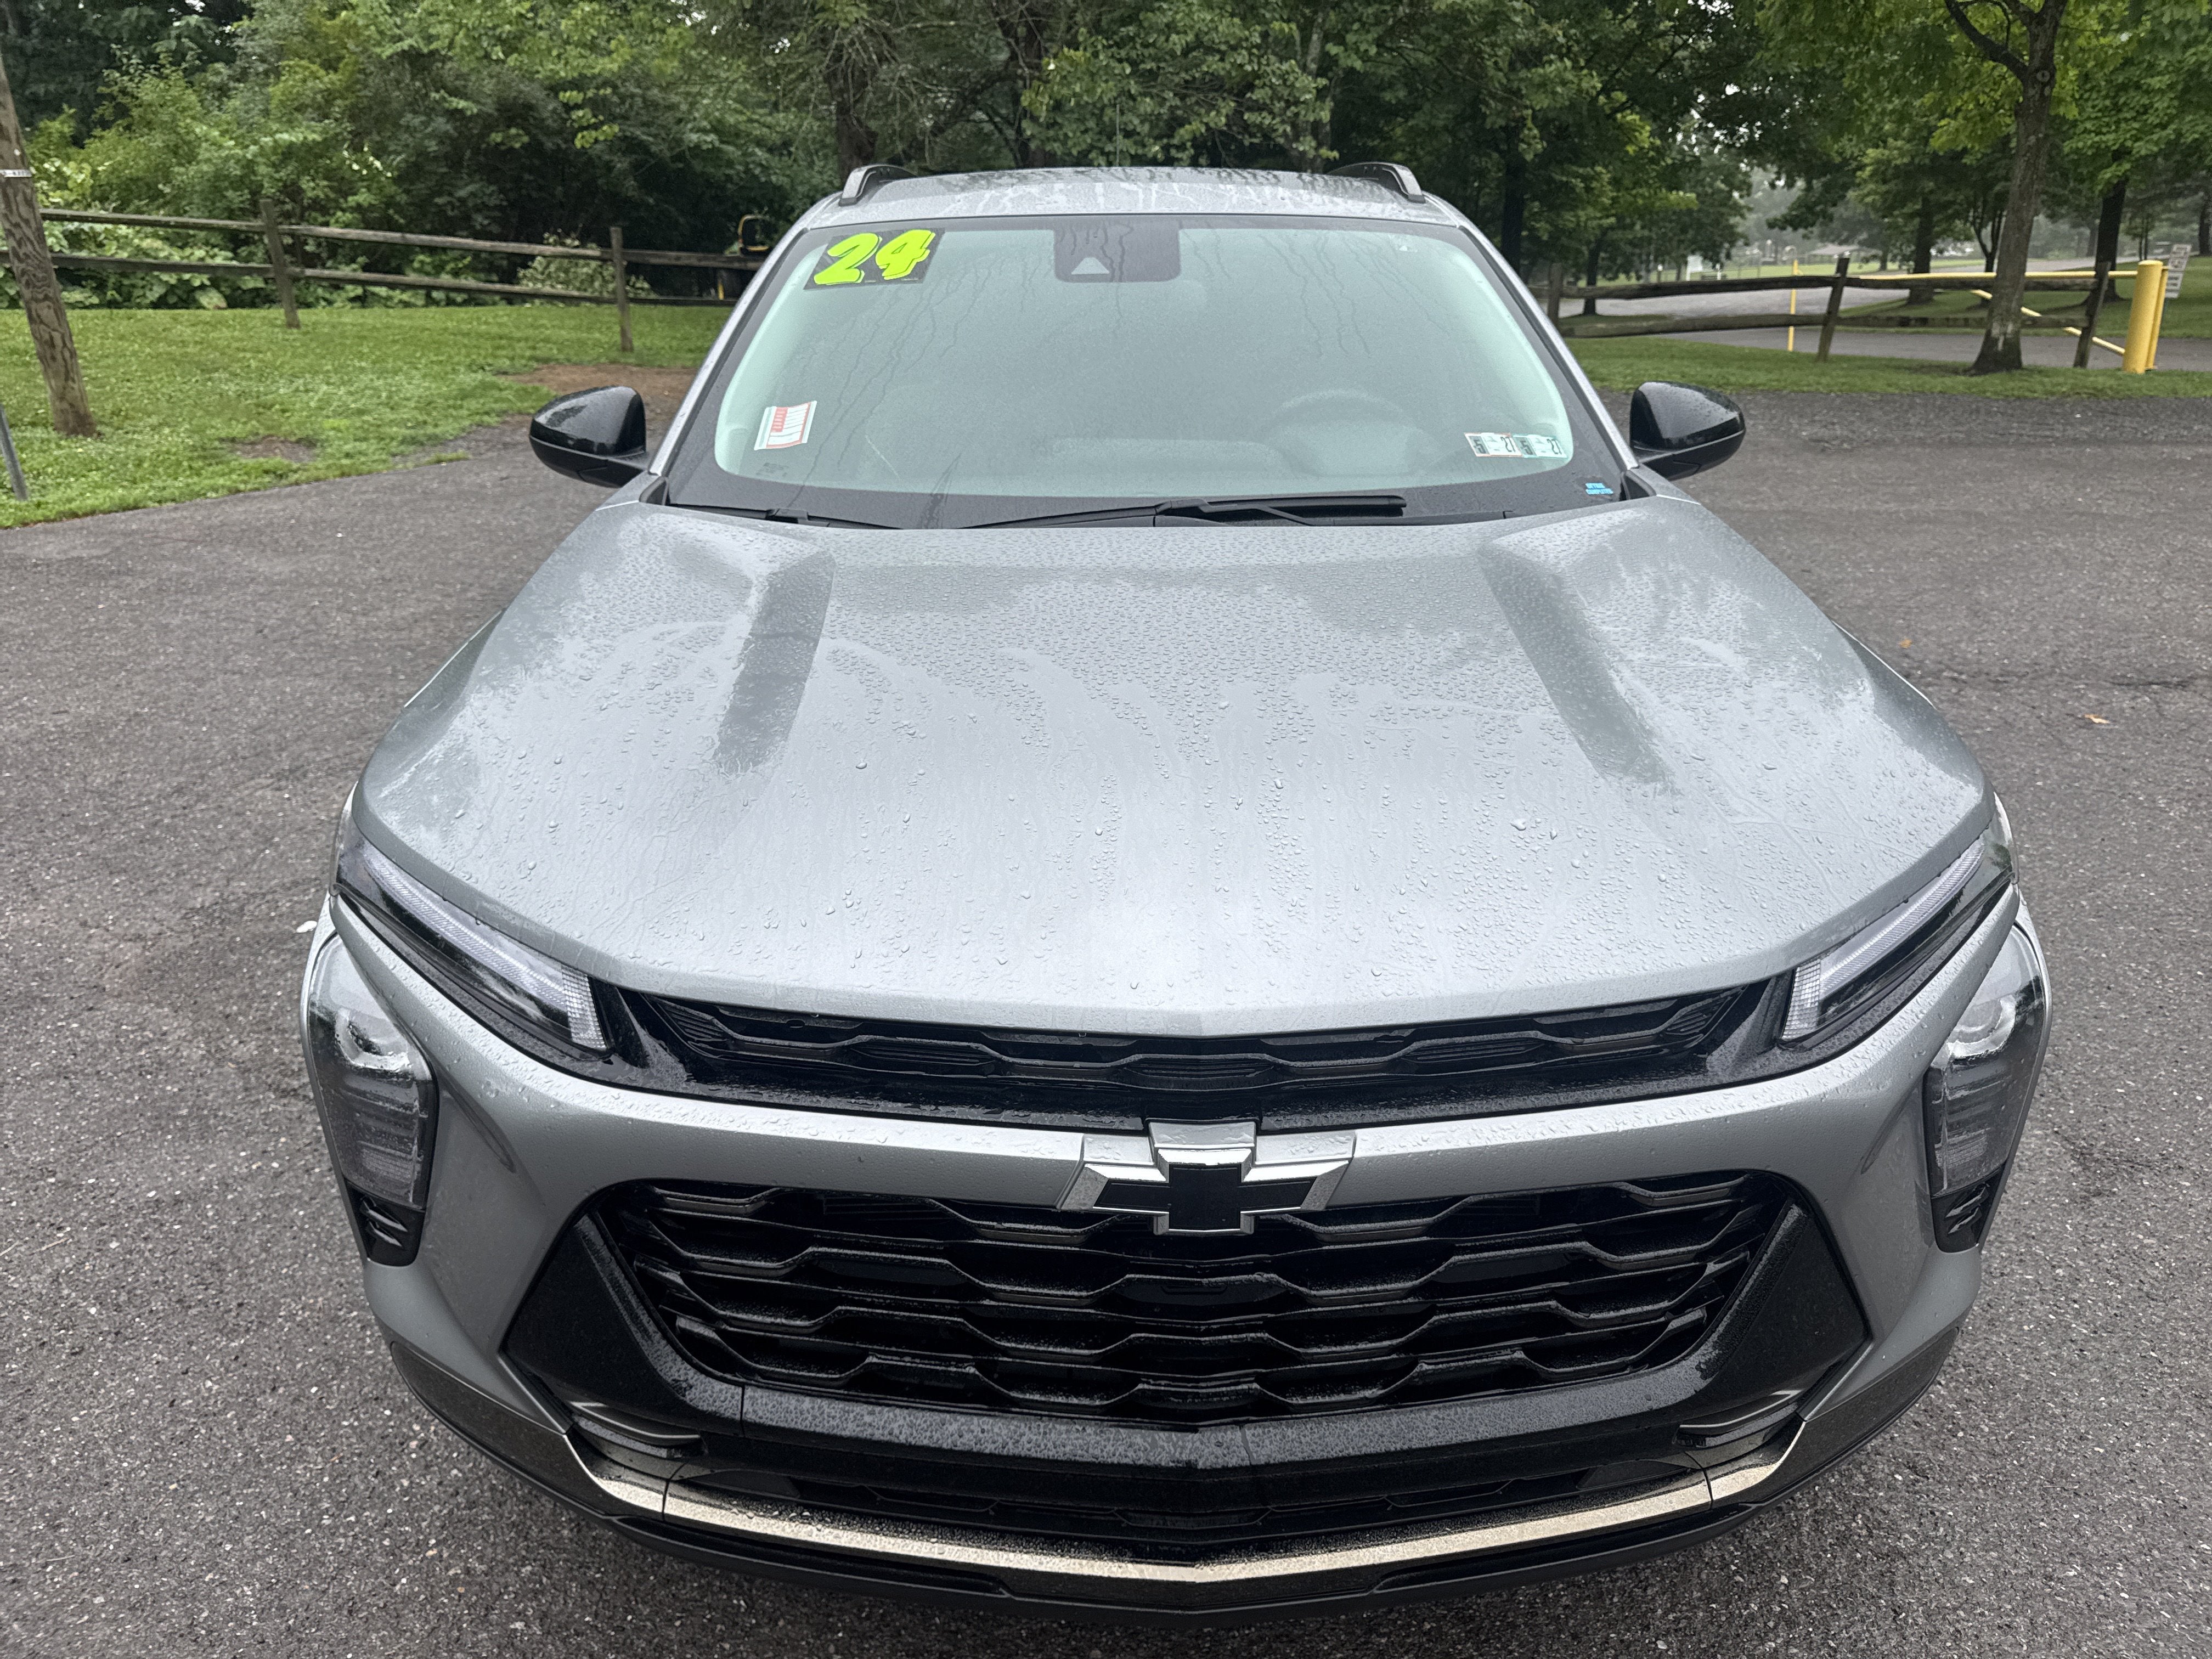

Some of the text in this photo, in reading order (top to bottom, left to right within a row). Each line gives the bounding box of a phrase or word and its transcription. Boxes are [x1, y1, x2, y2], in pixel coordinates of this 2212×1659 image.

[814, 229, 935, 285] 24
[1473, 439, 1486, 454] 5
[1520, 440, 1533, 455] 5
